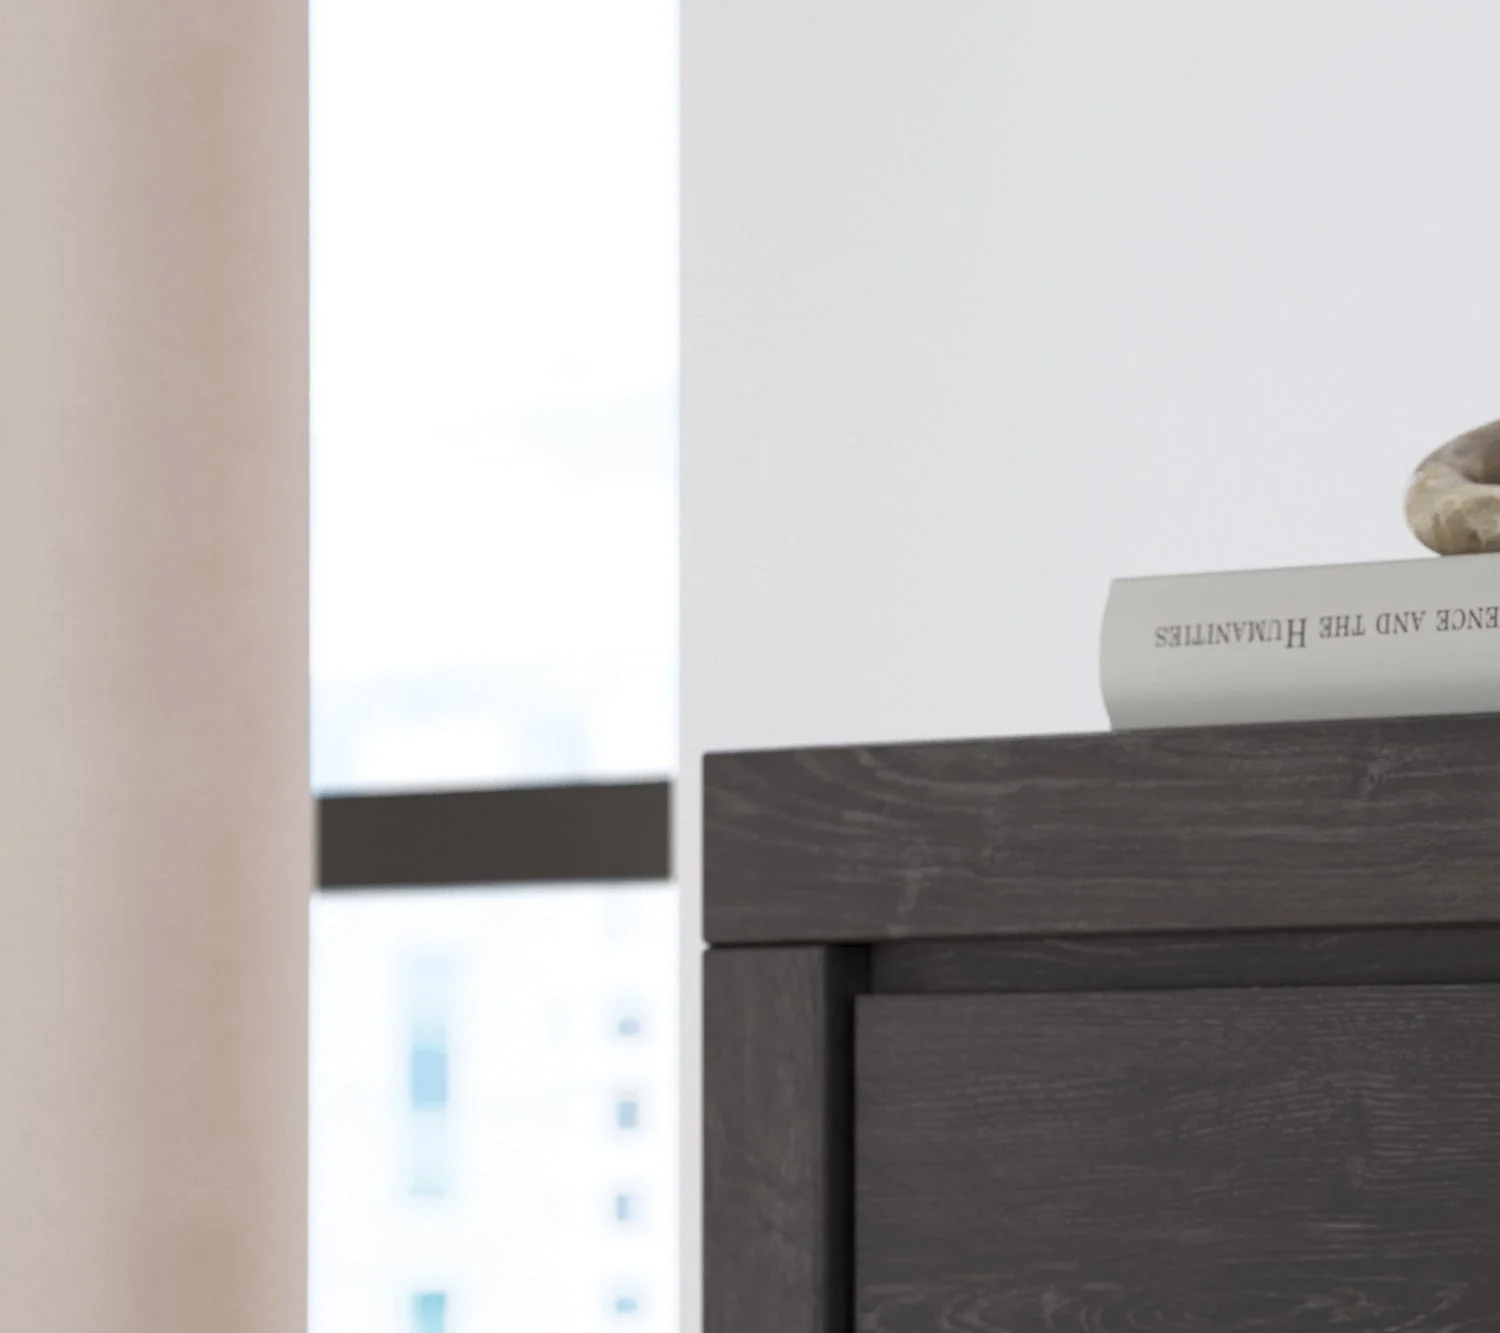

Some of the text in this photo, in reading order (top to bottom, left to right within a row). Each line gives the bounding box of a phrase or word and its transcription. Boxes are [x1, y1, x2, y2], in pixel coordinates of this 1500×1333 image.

[1154, 617, 1308, 650] HUMANITIES
[1319, 613, 1366, 640] THE
[1375, 609, 1427, 636] AND
